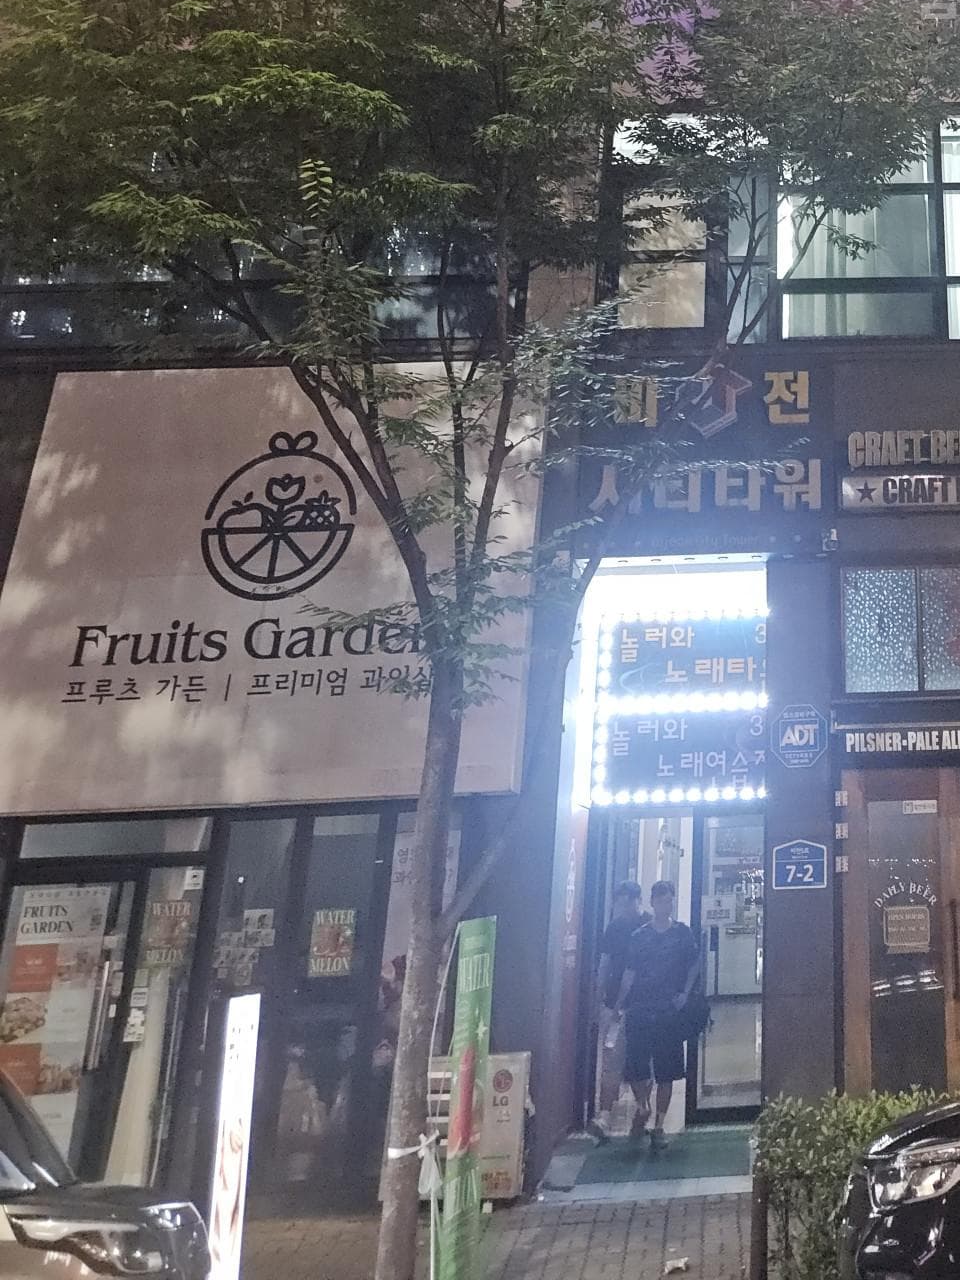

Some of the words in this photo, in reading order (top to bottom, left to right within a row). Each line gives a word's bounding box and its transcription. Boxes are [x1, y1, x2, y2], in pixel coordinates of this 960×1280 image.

[848, 430, 926, 468] CRAFT
[882, 475, 952, 505] CRAFT
[69, 620, 228, 667] Fruits
[621, 625, 695, 663] 놀러와
[61, 677, 141, 704] 프루츠
[156, 674, 207, 703] 가든
[246, 667, 348, 696] 프리미엄
[612, 718, 688, 756] 놀러와
[780, 724, 817, 747] ADT
[785, 864, 814, 883] 7-2
[874, 881, 905, 908] DAILY
[909, 882, 937, 907] BEER
[22, 903, 69, 918] FRUITS
[152, 901, 193, 916] WATER
[314, 910, 355, 925] WATER
[19, 920, 73, 935] GARDEN
[309, 956, 351, 973] MELON
[492, 1094, 510, 1107] LG
